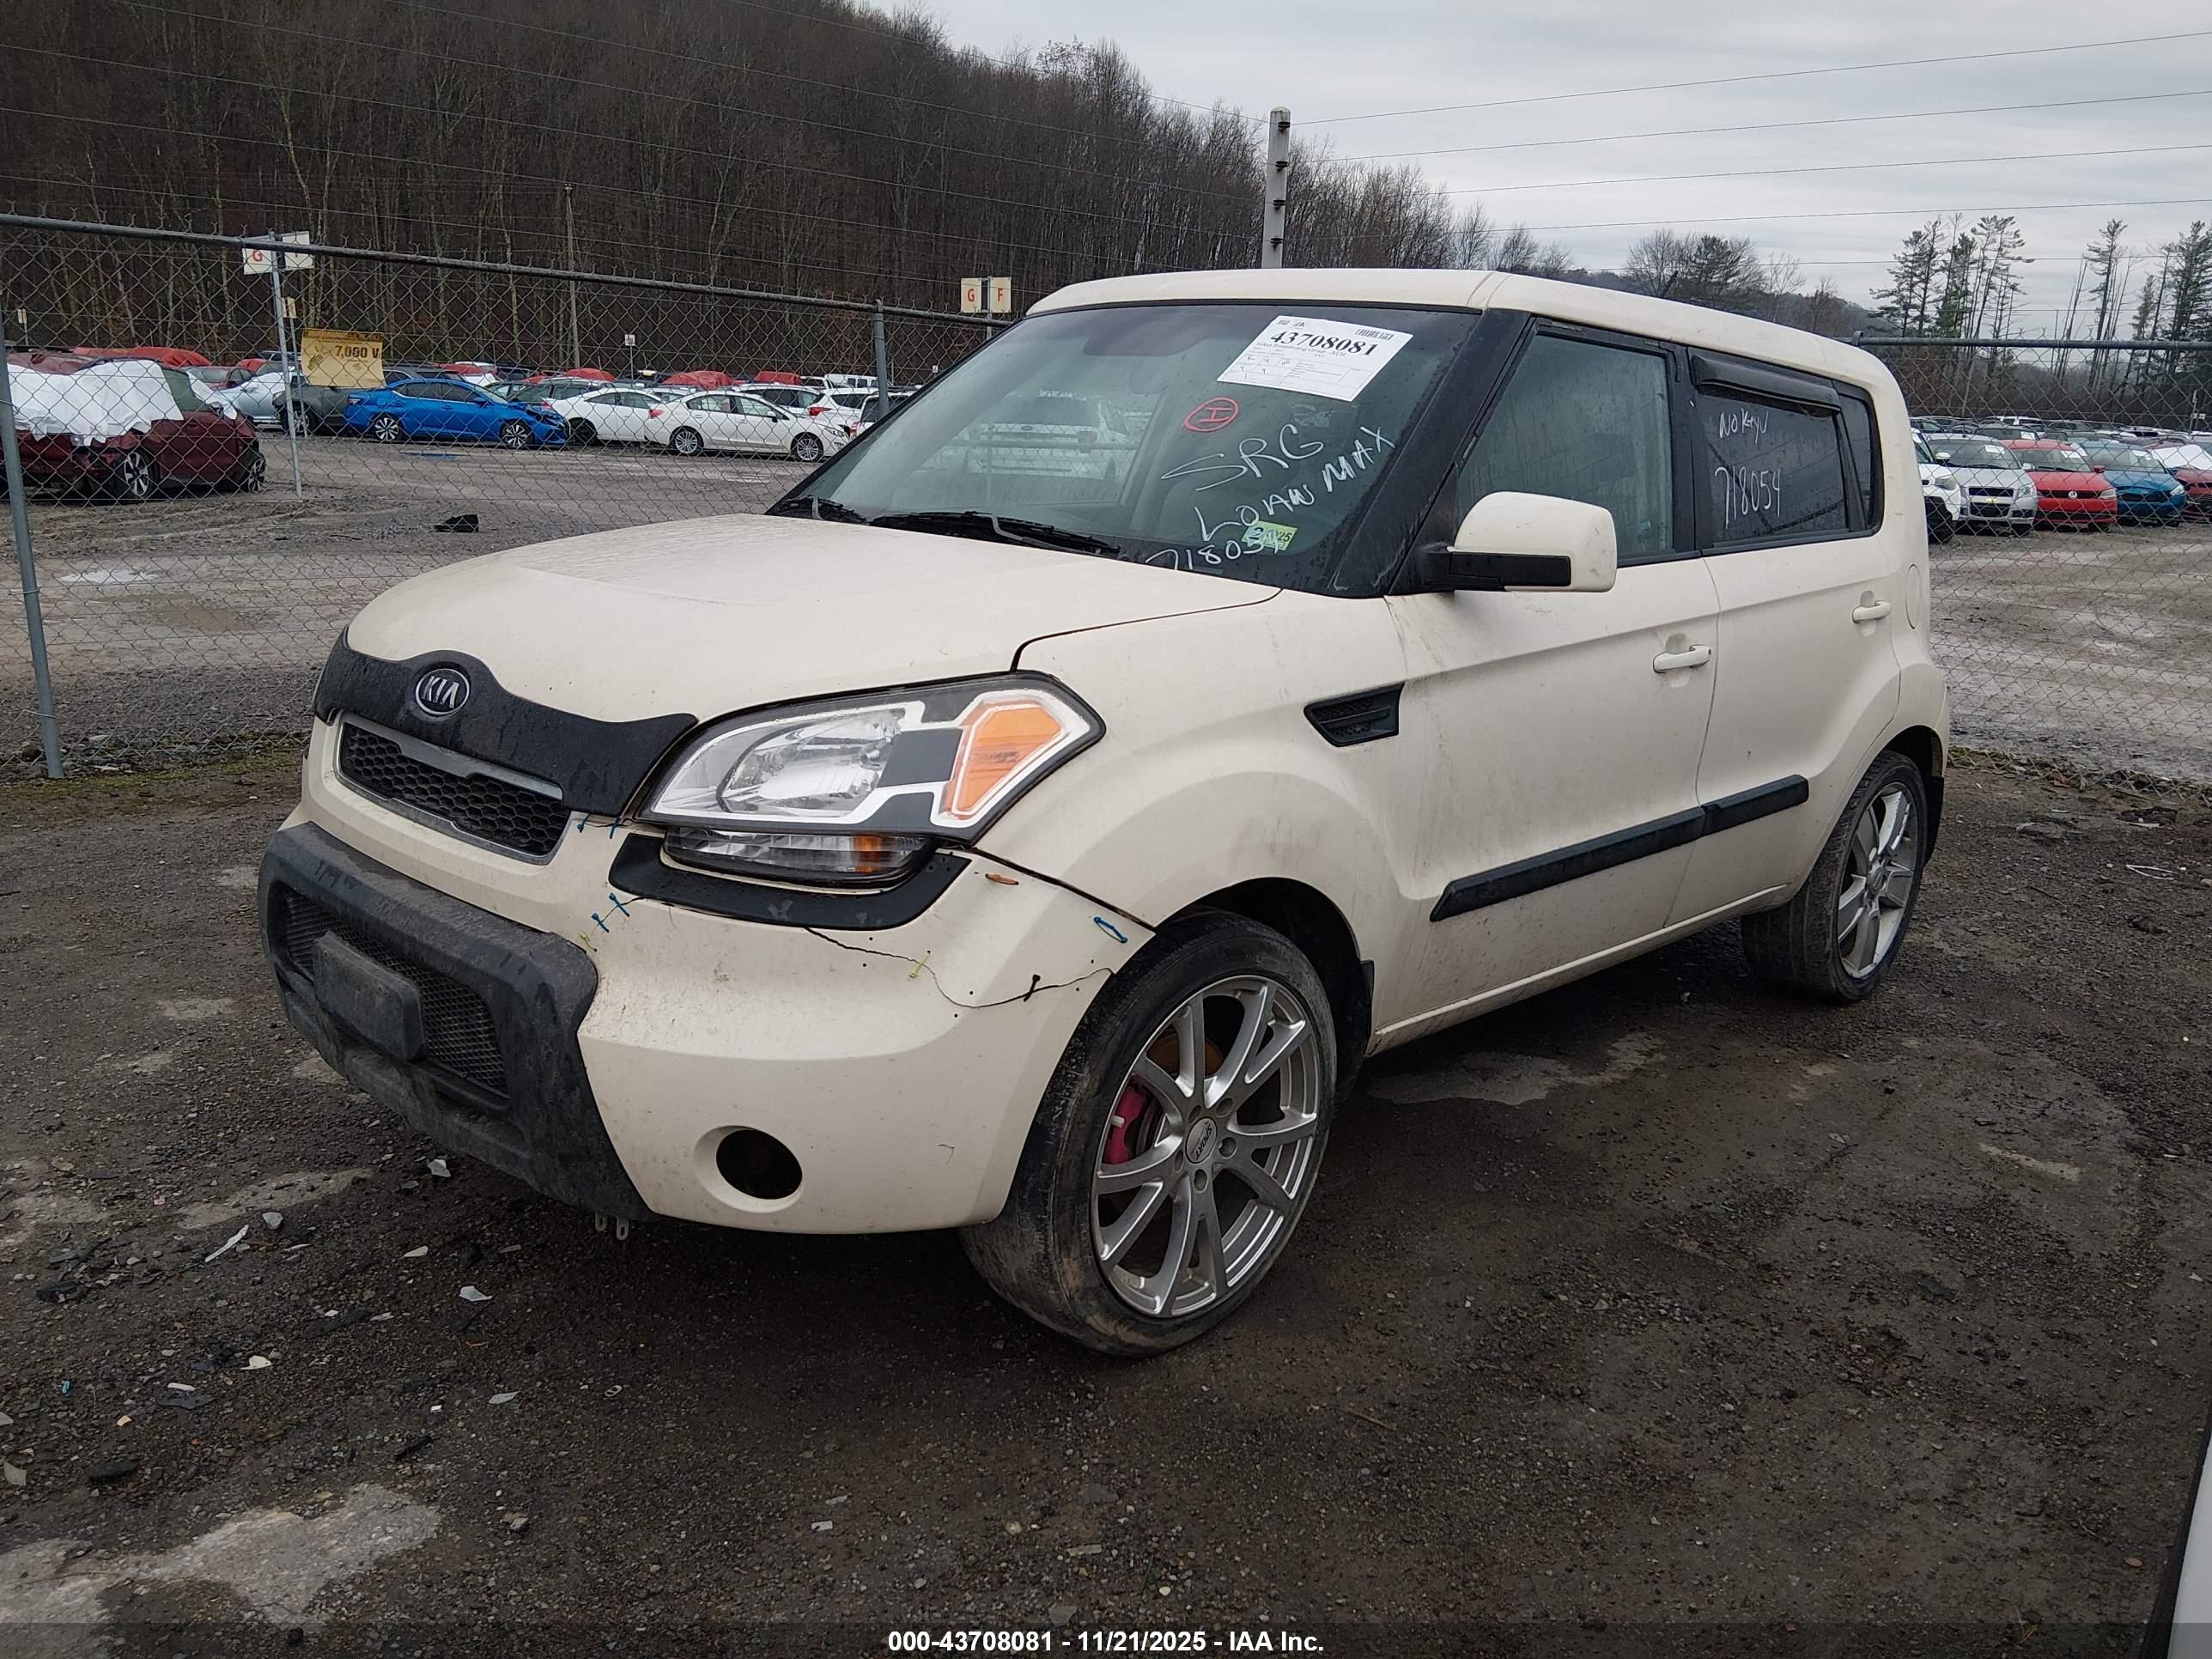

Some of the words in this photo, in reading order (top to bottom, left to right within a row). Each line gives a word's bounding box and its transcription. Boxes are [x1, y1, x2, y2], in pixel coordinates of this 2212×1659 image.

[967, 288, 975, 302] G
[997, 288, 1004, 302] F
[1270, 331, 1379, 356] 43708081
[1161, 423, 1324, 491] SRG
[1322, 426, 1395, 493] MAX
[1714, 466, 1781, 530] 718054
[421, 675, 460, 709] KIA
